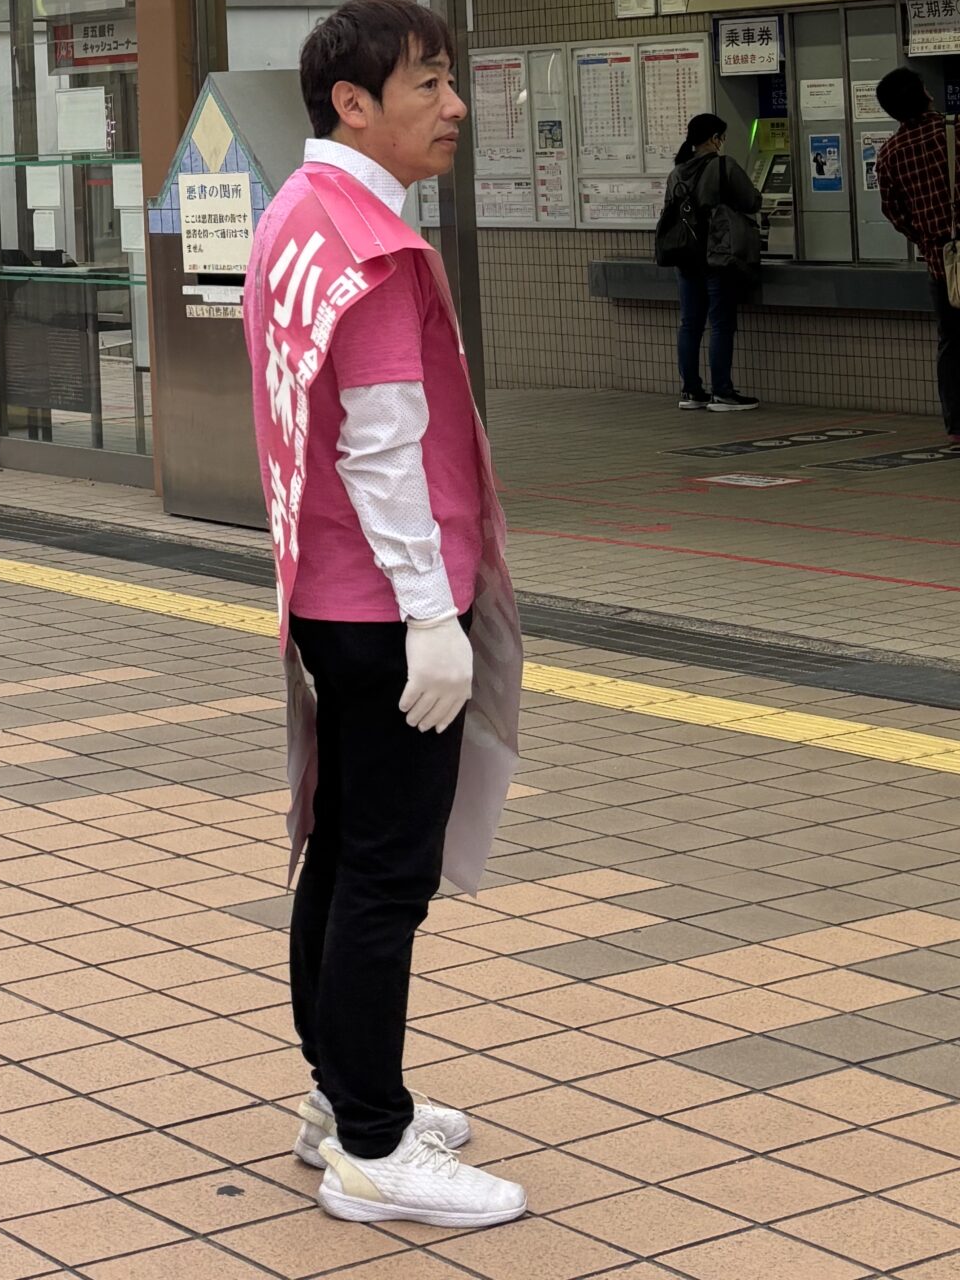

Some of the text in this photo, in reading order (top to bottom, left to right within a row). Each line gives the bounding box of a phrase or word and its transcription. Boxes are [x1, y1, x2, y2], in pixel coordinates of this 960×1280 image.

[725, 25, 773, 48] 乗車券
[82, 37, 139, 54] キャッシュコーナー
[724, 52, 775, 66] 近鉄線きっぷ
[185, 183, 242, 200] 悪書の関所
[186, 243, 204, 253] ません
